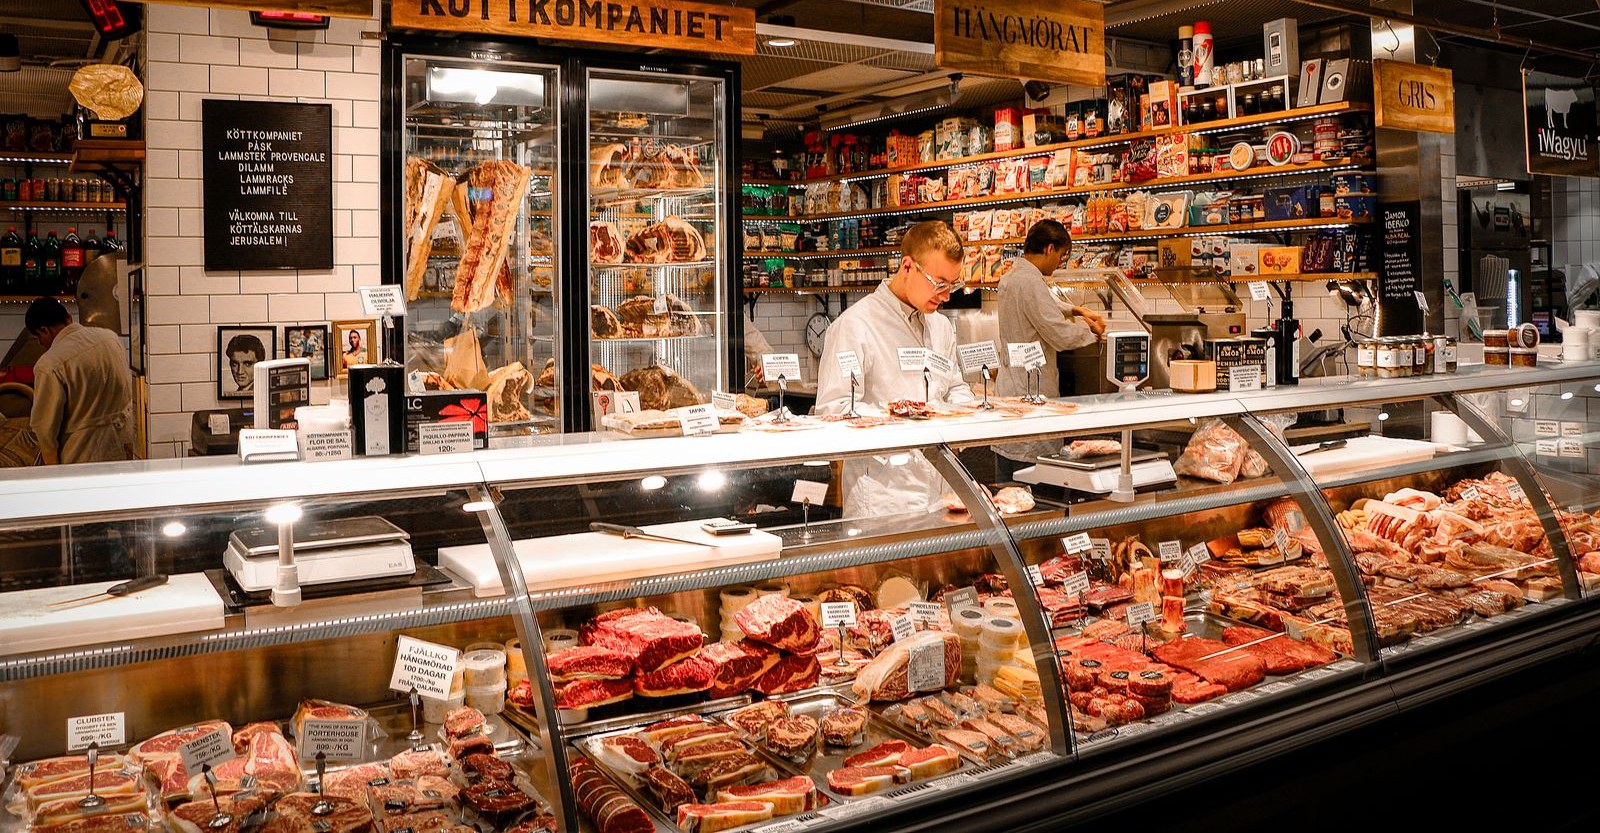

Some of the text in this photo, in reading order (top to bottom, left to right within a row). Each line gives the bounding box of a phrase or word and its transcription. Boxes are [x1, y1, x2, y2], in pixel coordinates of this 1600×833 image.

[954, 5, 1094, 54] HÄNGMÖRAT
[1398, 79, 1436, 110] GRIS
[226, 128, 302, 140] KÖTTKOMPANIET
[248, 139, 272, 151] PÅSK
[1538, 128, 1588, 160] iWagyu
[219, 152, 325, 162] LAMMSTEK PROVENCALE
[238, 164, 274, 172] DILAMM
[240, 175, 294, 184] LAMMRACKS
[229, 209, 298, 221] VÄLKOMNA TILL
[230, 222, 302, 233] KÖTTÄLSKARNAS
[409, 646, 448, 660] FJÄLLKO
[400, 654, 452, 671] HÄNGMÖRAD
[404, 664, 446, 680] 100 DAGAR
[417, 683, 444, 694] DALARNA
[76, 715, 116, 724] CLUBSTEK
[186, 731, 220, 750] T-BENSTEK
